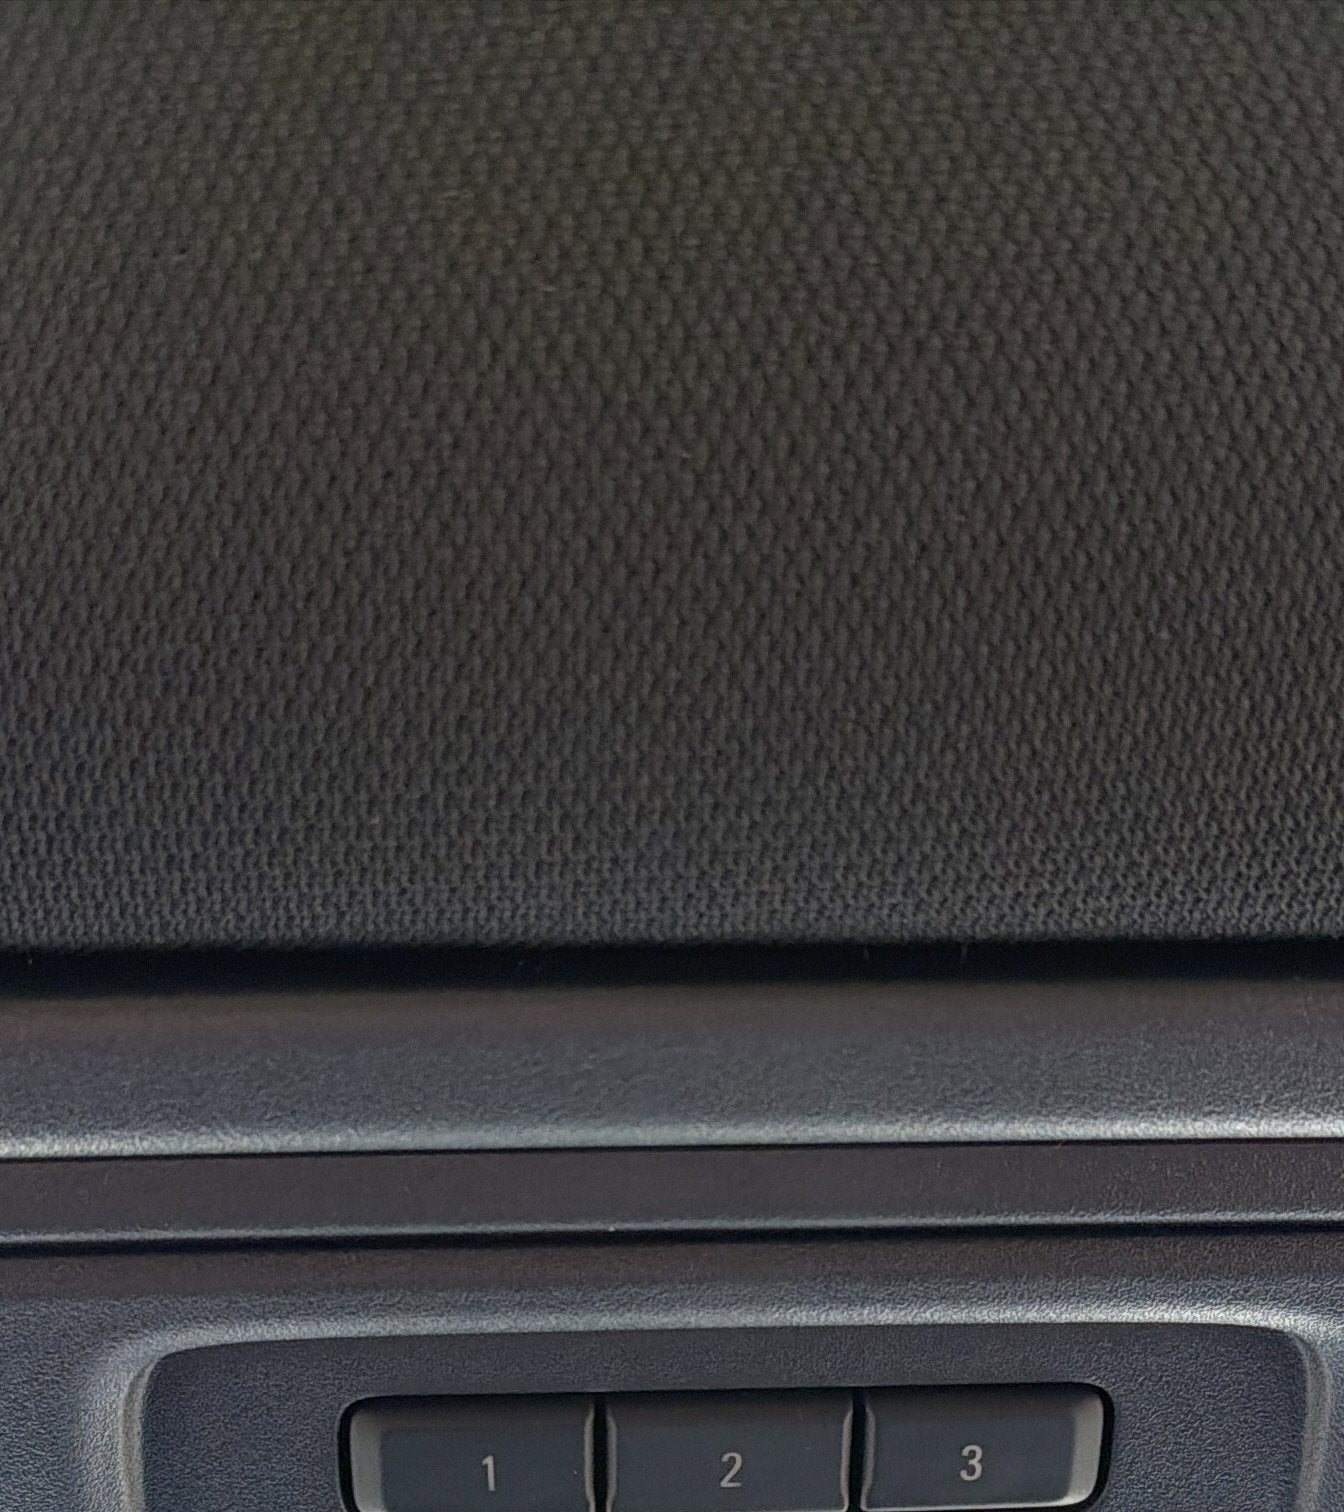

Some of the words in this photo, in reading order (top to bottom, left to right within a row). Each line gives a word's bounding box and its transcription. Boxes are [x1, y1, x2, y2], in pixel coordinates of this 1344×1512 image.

[480, 1454, 497, 1492] 1
[718, 1451, 744, 1489] 2
[958, 1443, 985, 1482] 3
